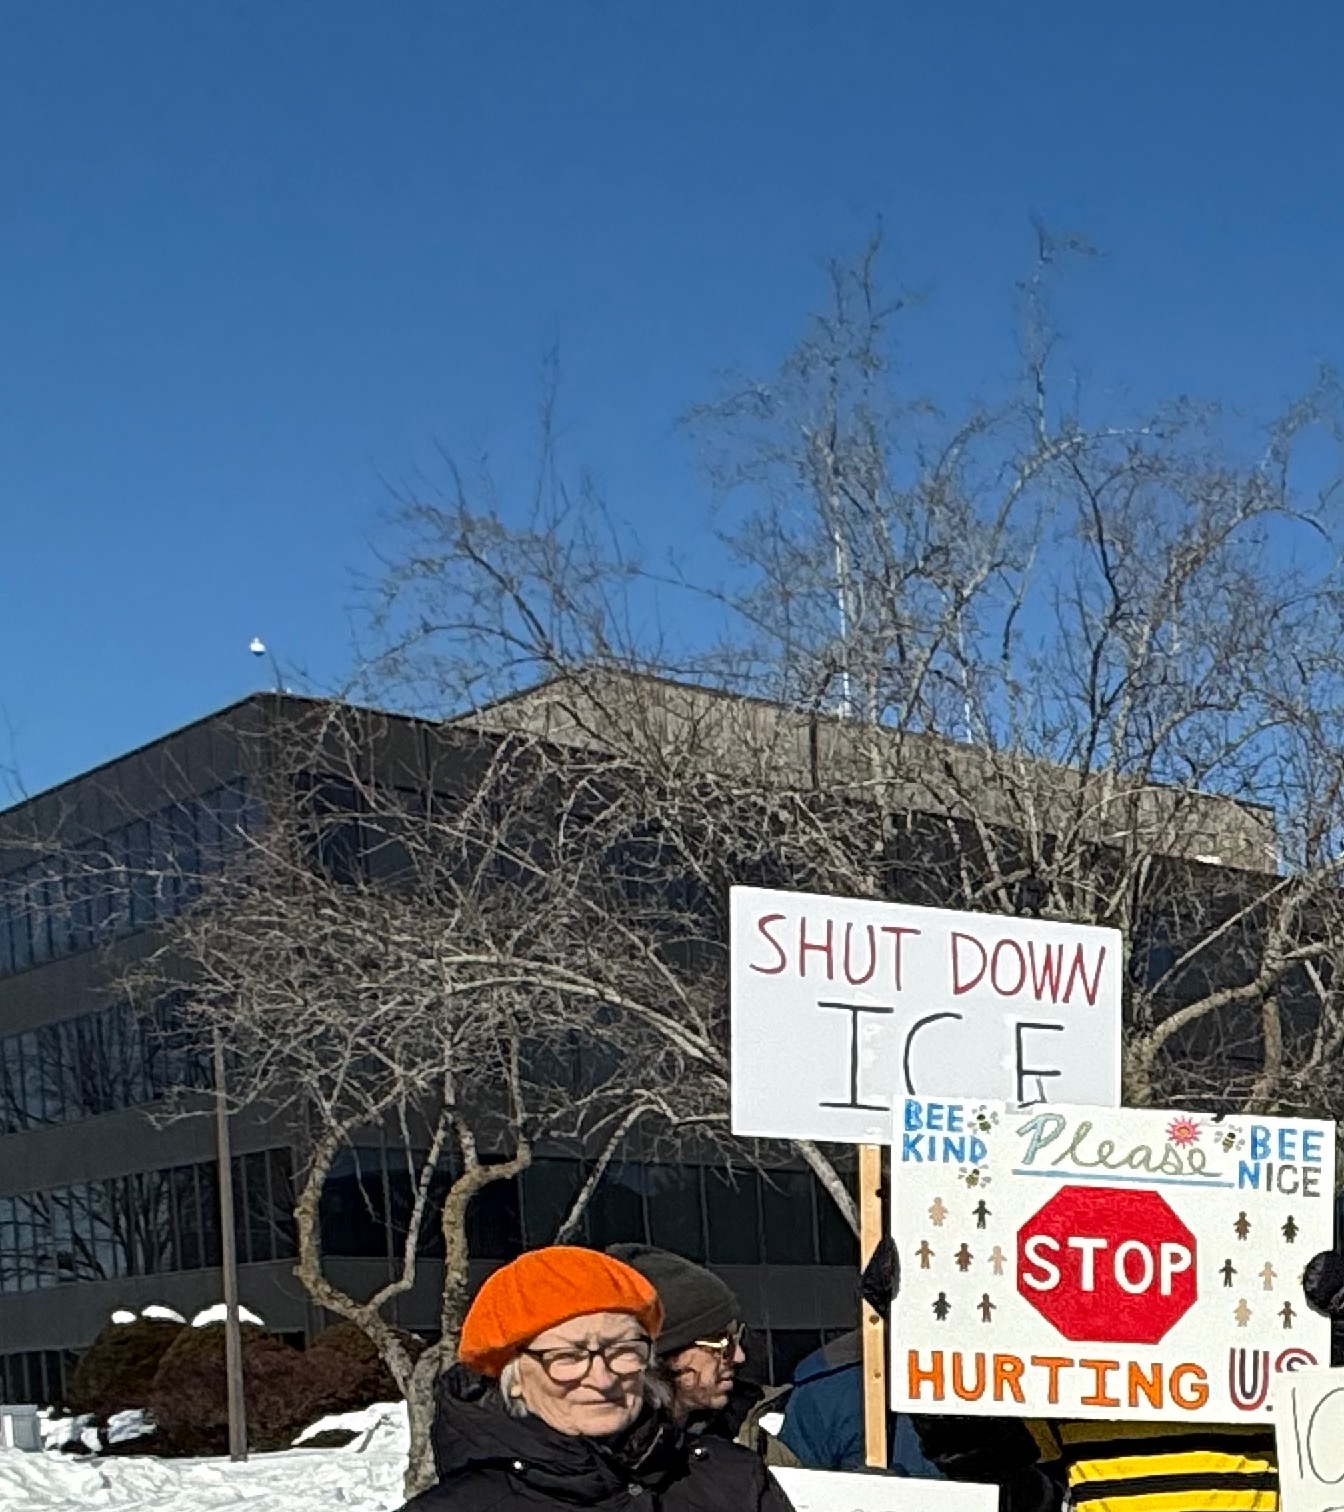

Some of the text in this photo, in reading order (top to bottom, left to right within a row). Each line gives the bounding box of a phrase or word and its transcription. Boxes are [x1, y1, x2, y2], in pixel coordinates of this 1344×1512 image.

[749, 913, 1106, 1007] SHUT DOWN
[903, 1102, 964, 1132] BEE
[901, 1133, 988, 1164] KIND
[1016, 1112, 1222, 1178] Please
[1248, 1125, 1324, 1162] BEE
[1237, 1163, 1322, 1198] NICE
[1021, 1234, 1191, 1296] STOP
[908, 1350, 1210, 1409] HURTING
